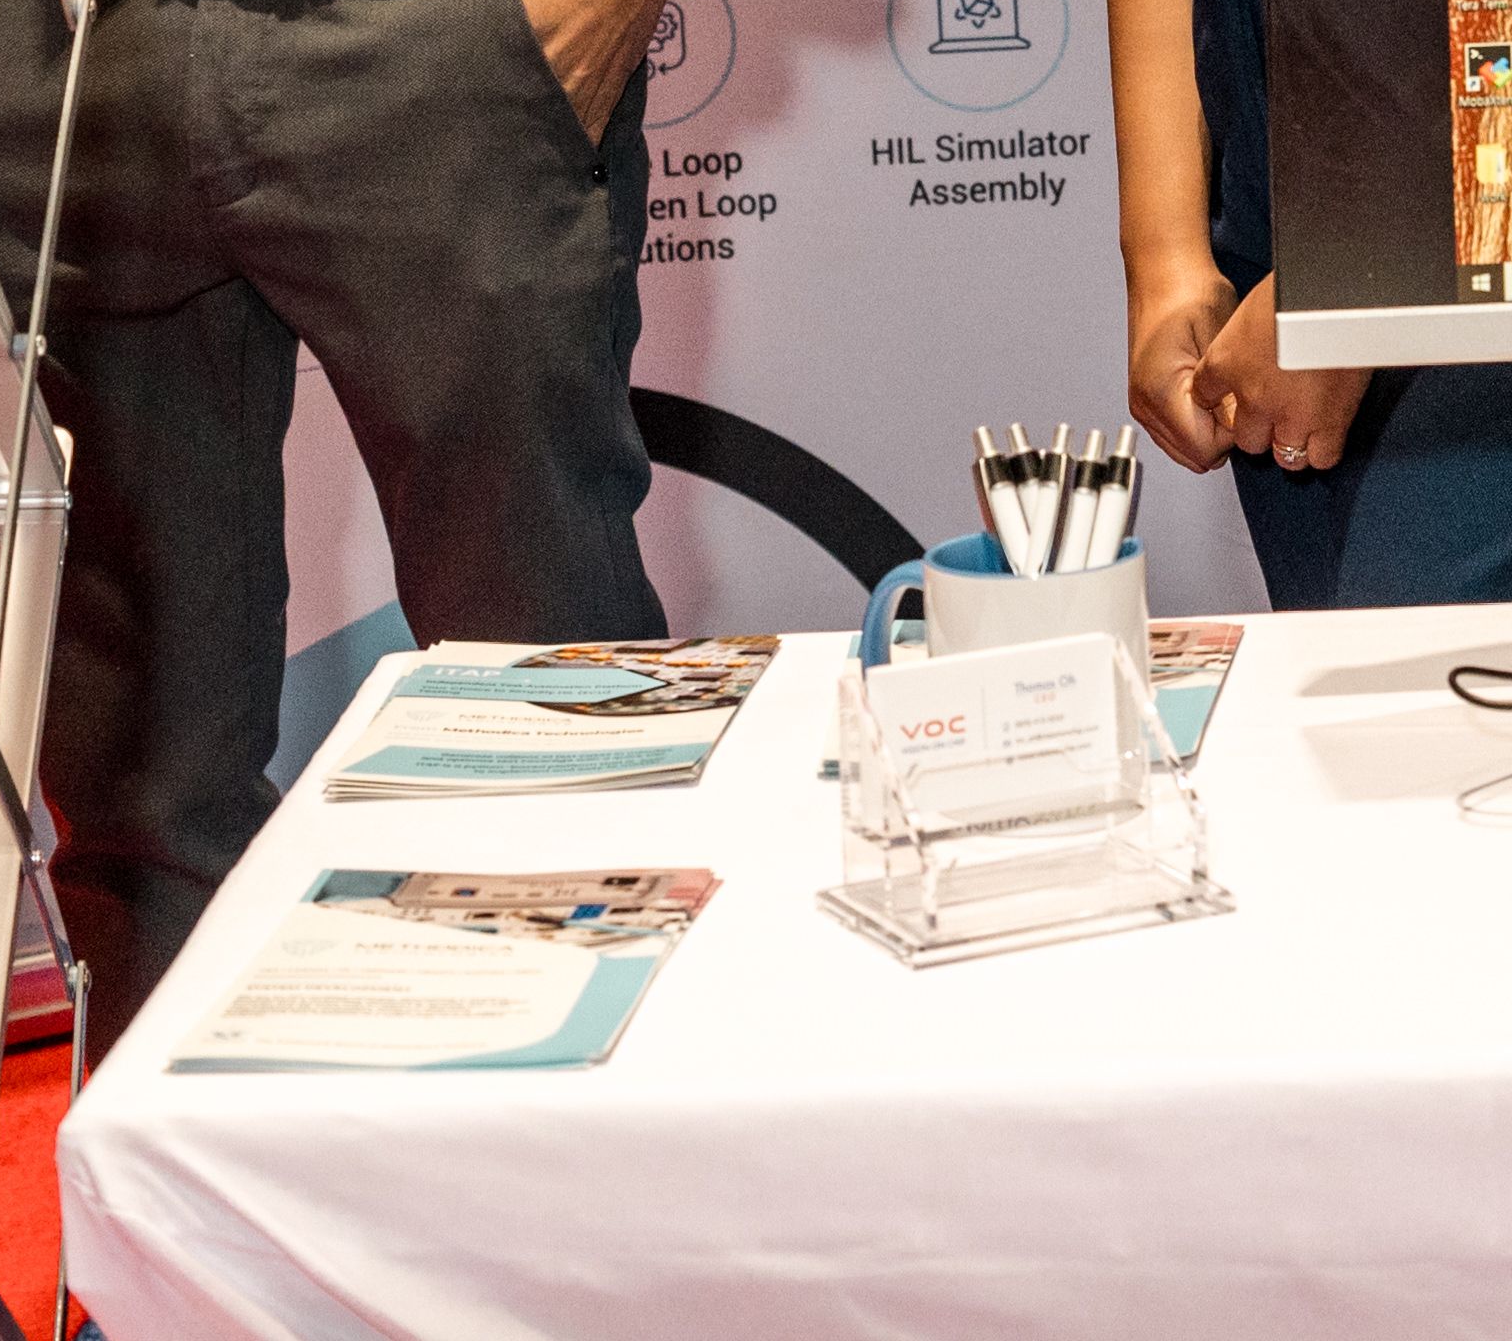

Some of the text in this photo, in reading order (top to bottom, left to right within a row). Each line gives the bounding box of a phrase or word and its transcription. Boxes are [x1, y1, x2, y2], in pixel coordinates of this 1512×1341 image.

[663, 146, 743, 179] Loop
[871, 129, 1091, 166] HIL Simulator
[698, 188, 778, 222] Loop
[909, 173, 1067, 207] Assembly
[433, 667, 503, 678] iTAP
[899, 715, 966, 741] VOC
